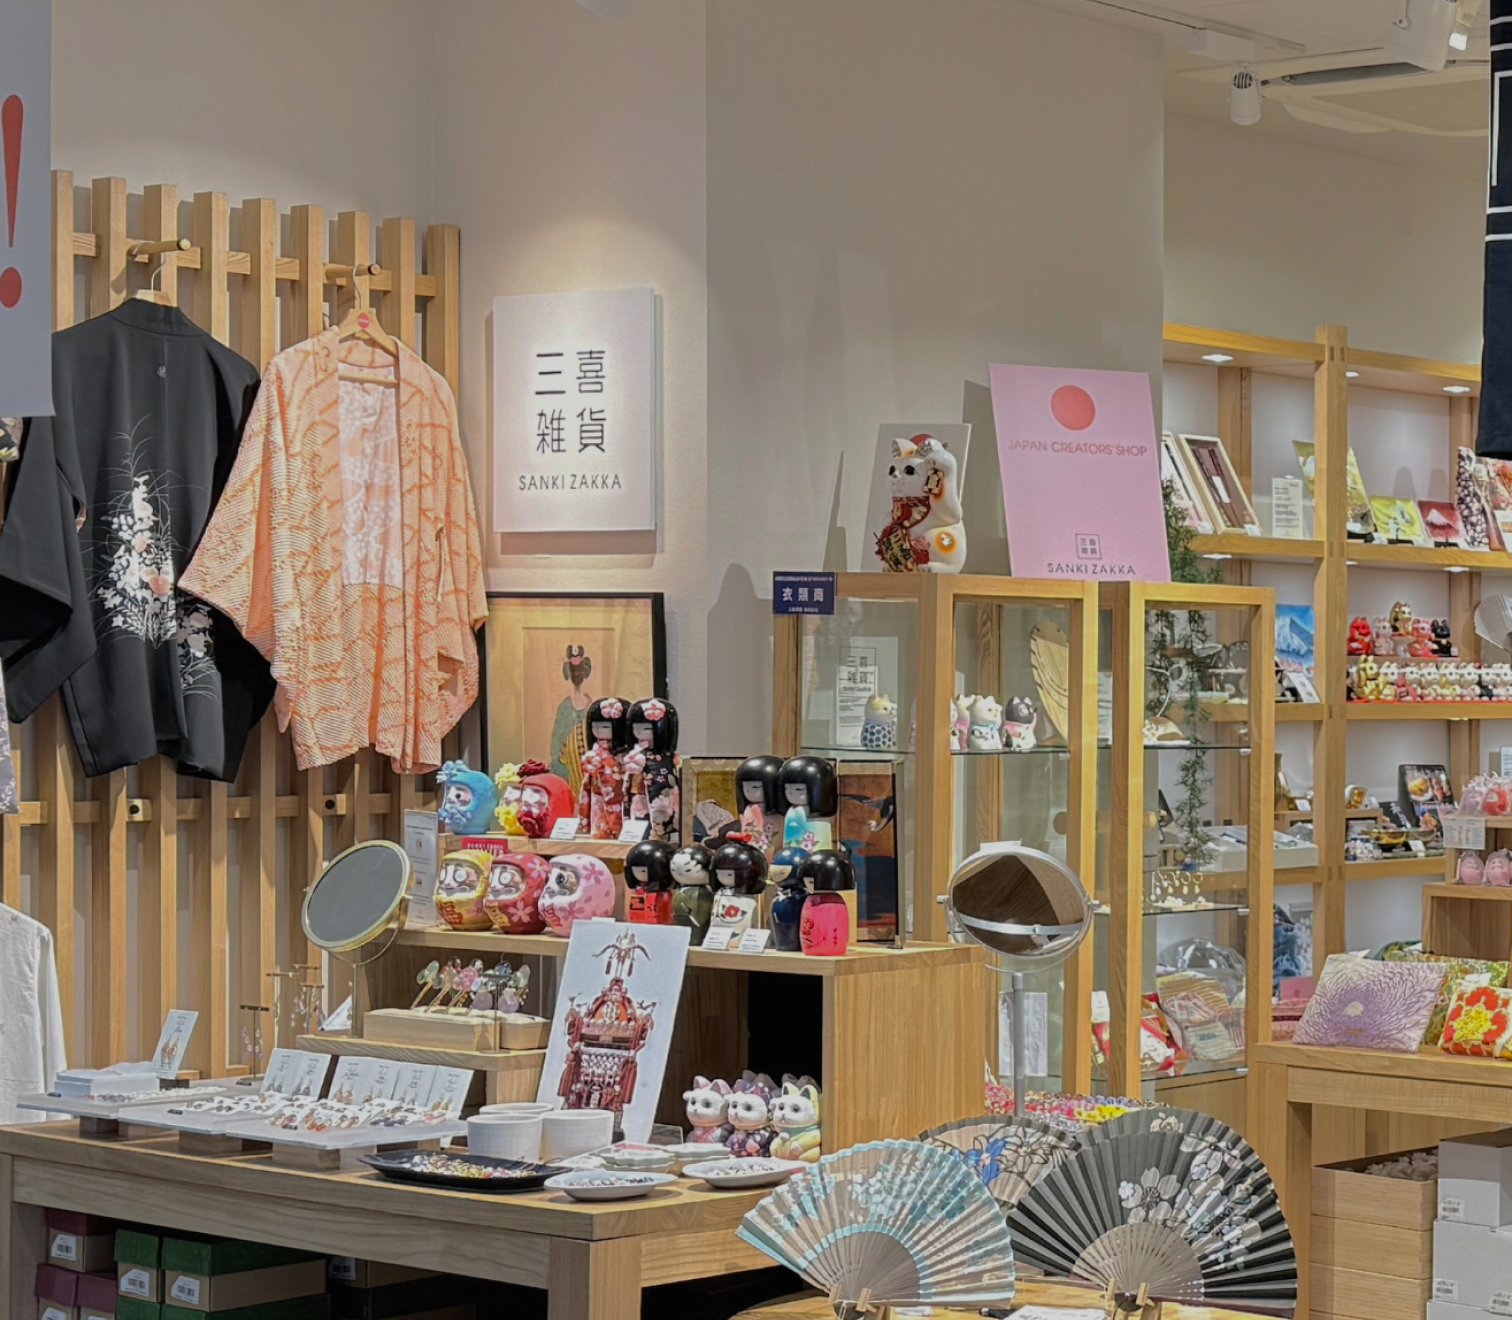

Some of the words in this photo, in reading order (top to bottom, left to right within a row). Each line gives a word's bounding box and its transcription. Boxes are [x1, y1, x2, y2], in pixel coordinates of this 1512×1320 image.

[534, 350, 607, 396] 三喜
[536, 407, 607, 454] 雑貨
[1007, 439, 1047, 452] JAPAN
[1116, 445, 1147, 457] SHOP
[518, 474, 565, 491] SANKI
[570, 473, 622, 490] ZAKKA
[1047, 562, 1088, 574] SANKI
[1092, 563, 1136, 575] ZAKKA
